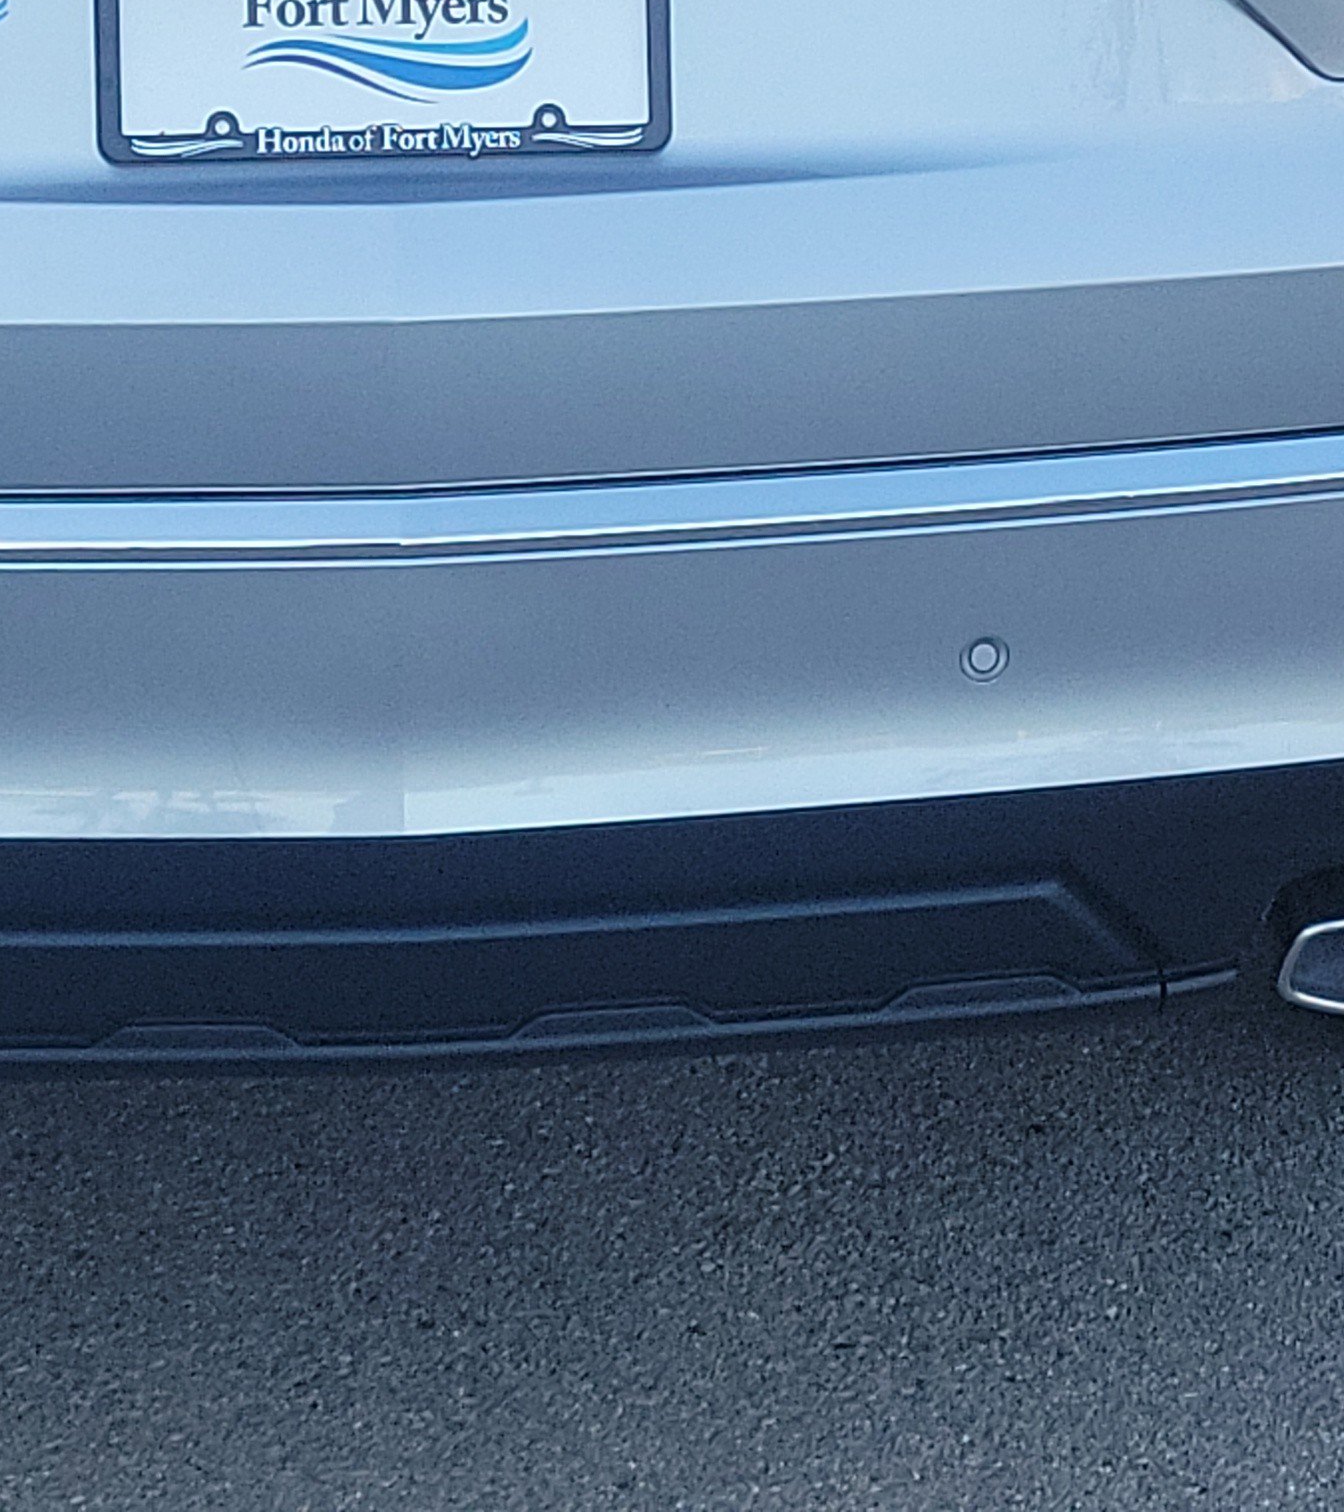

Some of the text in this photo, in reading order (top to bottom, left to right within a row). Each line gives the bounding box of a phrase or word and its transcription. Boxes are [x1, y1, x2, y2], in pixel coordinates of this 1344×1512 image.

[256, 122, 521, 157] Honda of Fort Myers
